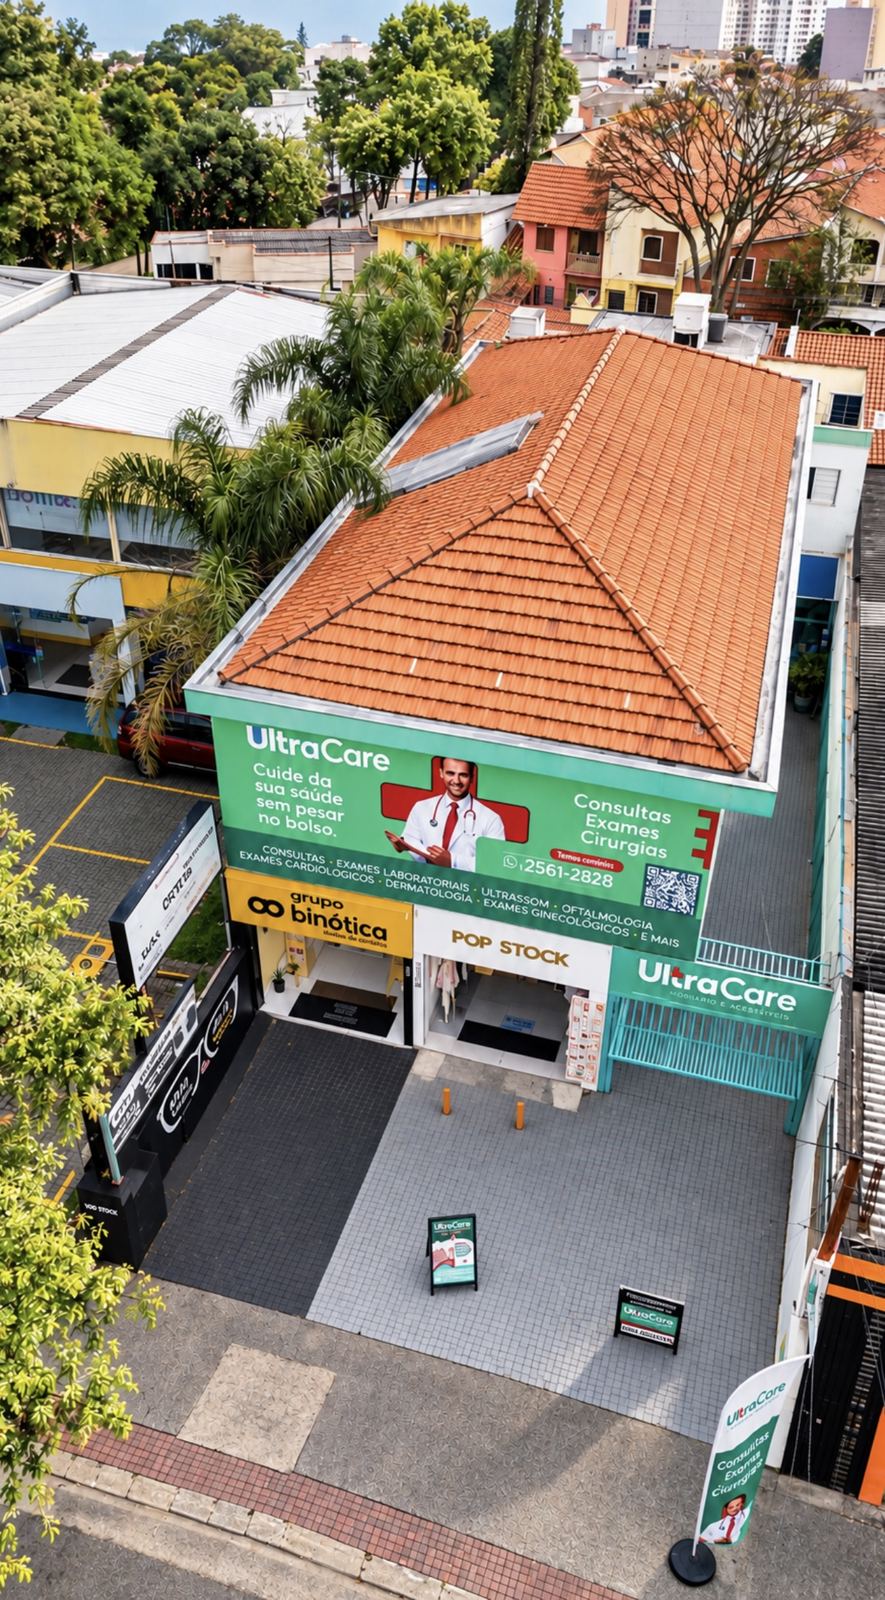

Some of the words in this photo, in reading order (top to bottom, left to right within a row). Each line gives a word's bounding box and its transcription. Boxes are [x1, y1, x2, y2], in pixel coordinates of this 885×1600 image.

[246, 725, 390, 771] UltraCare
[253, 763, 303, 783] Cuide
[309, 772, 332, 788] da
[255, 781, 285, 795] sua
[256, 797, 290, 812] sem
[296, 804, 344, 822] pesar
[574, 793, 672, 825] Consultas
[259, 813, 280, 826] no
[286, 815, 337, 837] bolso.
[585, 813, 660, 841] Exames
[557, 851, 581, 863] Temos
[581, 830, 667, 859] Cirurgias
[262, 845, 326, 864] CONSULTAS
[336, 859, 380, 875] EXAMES
[383, 868, 470, 892] LABORATORIAIS
[481, 887, 549, 908] ULTRASSOM
[562, 904, 653, 931] OFTALMOLOGIA
[524, 859, 614, 888] 2561-2828
[239, 850, 282, 866] EXAMES
[285, 860, 375, 884] CARDIOLOGICOS
[385, 878, 473, 904] DERMATOLOGIA
[484, 898, 528, 915] EXAMES
[532, 908, 629, 937] GINECOLÓGICOS
[641, 932, 648, 941] E
[651, 934, 680, 948] MAIS
[290, 892, 344, 910] grupo
[291, 904, 388, 941] binótica
[452, 930, 492, 949] POP
[500, 941, 569, 967] STOCK
[638, 958, 797, 1011] UltraCare
[98, 1206, 118, 1216] STOCK
